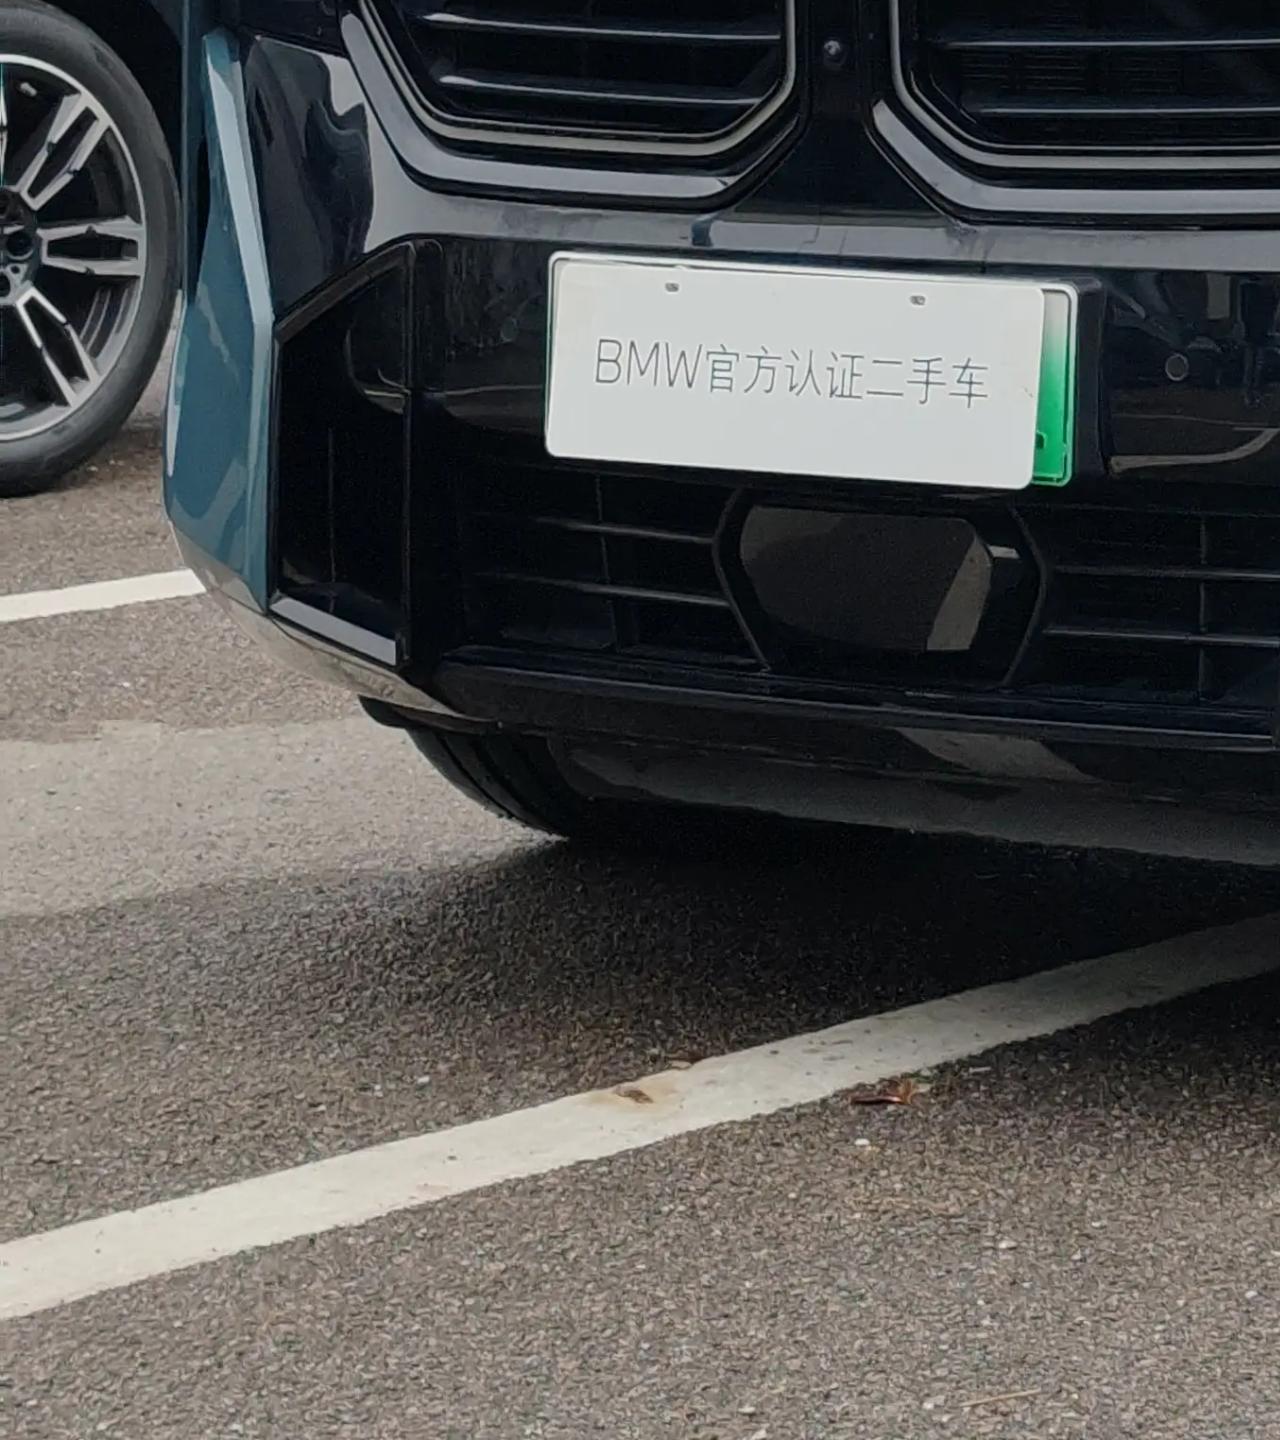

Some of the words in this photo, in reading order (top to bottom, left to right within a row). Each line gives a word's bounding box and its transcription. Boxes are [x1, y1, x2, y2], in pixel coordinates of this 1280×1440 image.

[594, 337, 989, 410] BMW官方认证二手车
